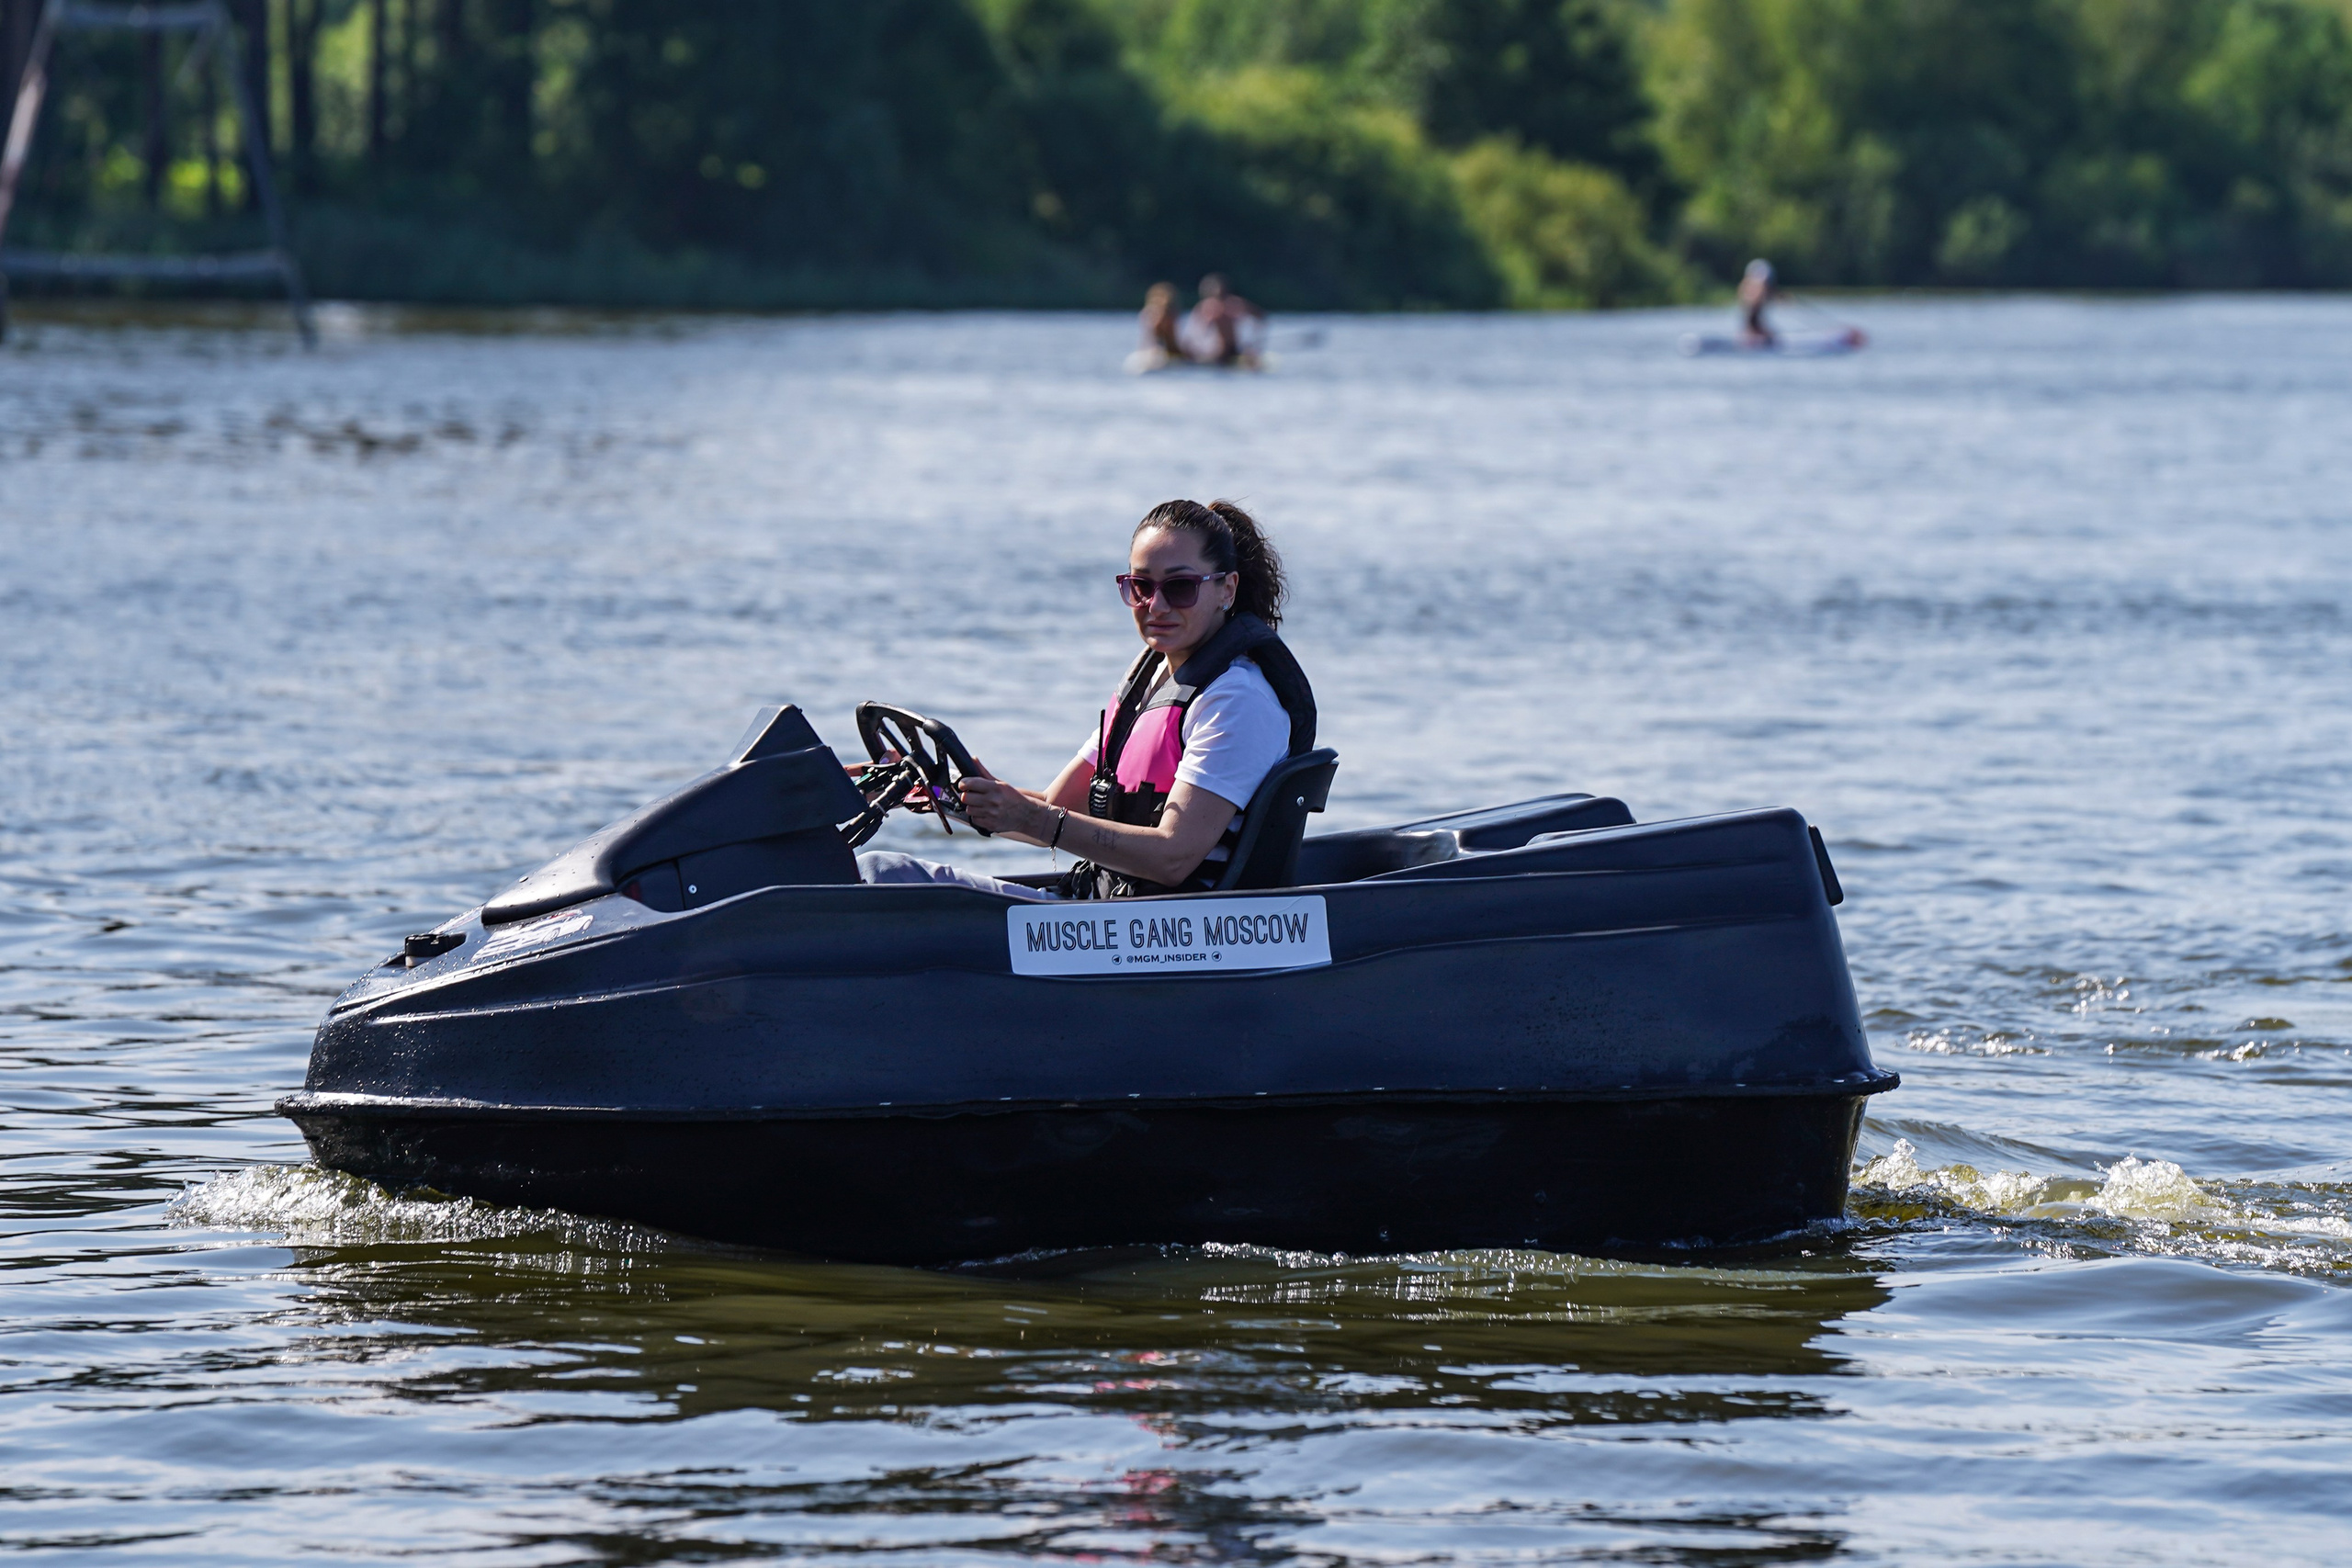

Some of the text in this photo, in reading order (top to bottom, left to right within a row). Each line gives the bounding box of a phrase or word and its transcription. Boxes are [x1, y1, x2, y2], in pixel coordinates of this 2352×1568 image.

[1025, 913, 1309, 952] MUSCLE GANG MOSCOW
[1126, 953, 1207, 964] @MGM_INSIDER
